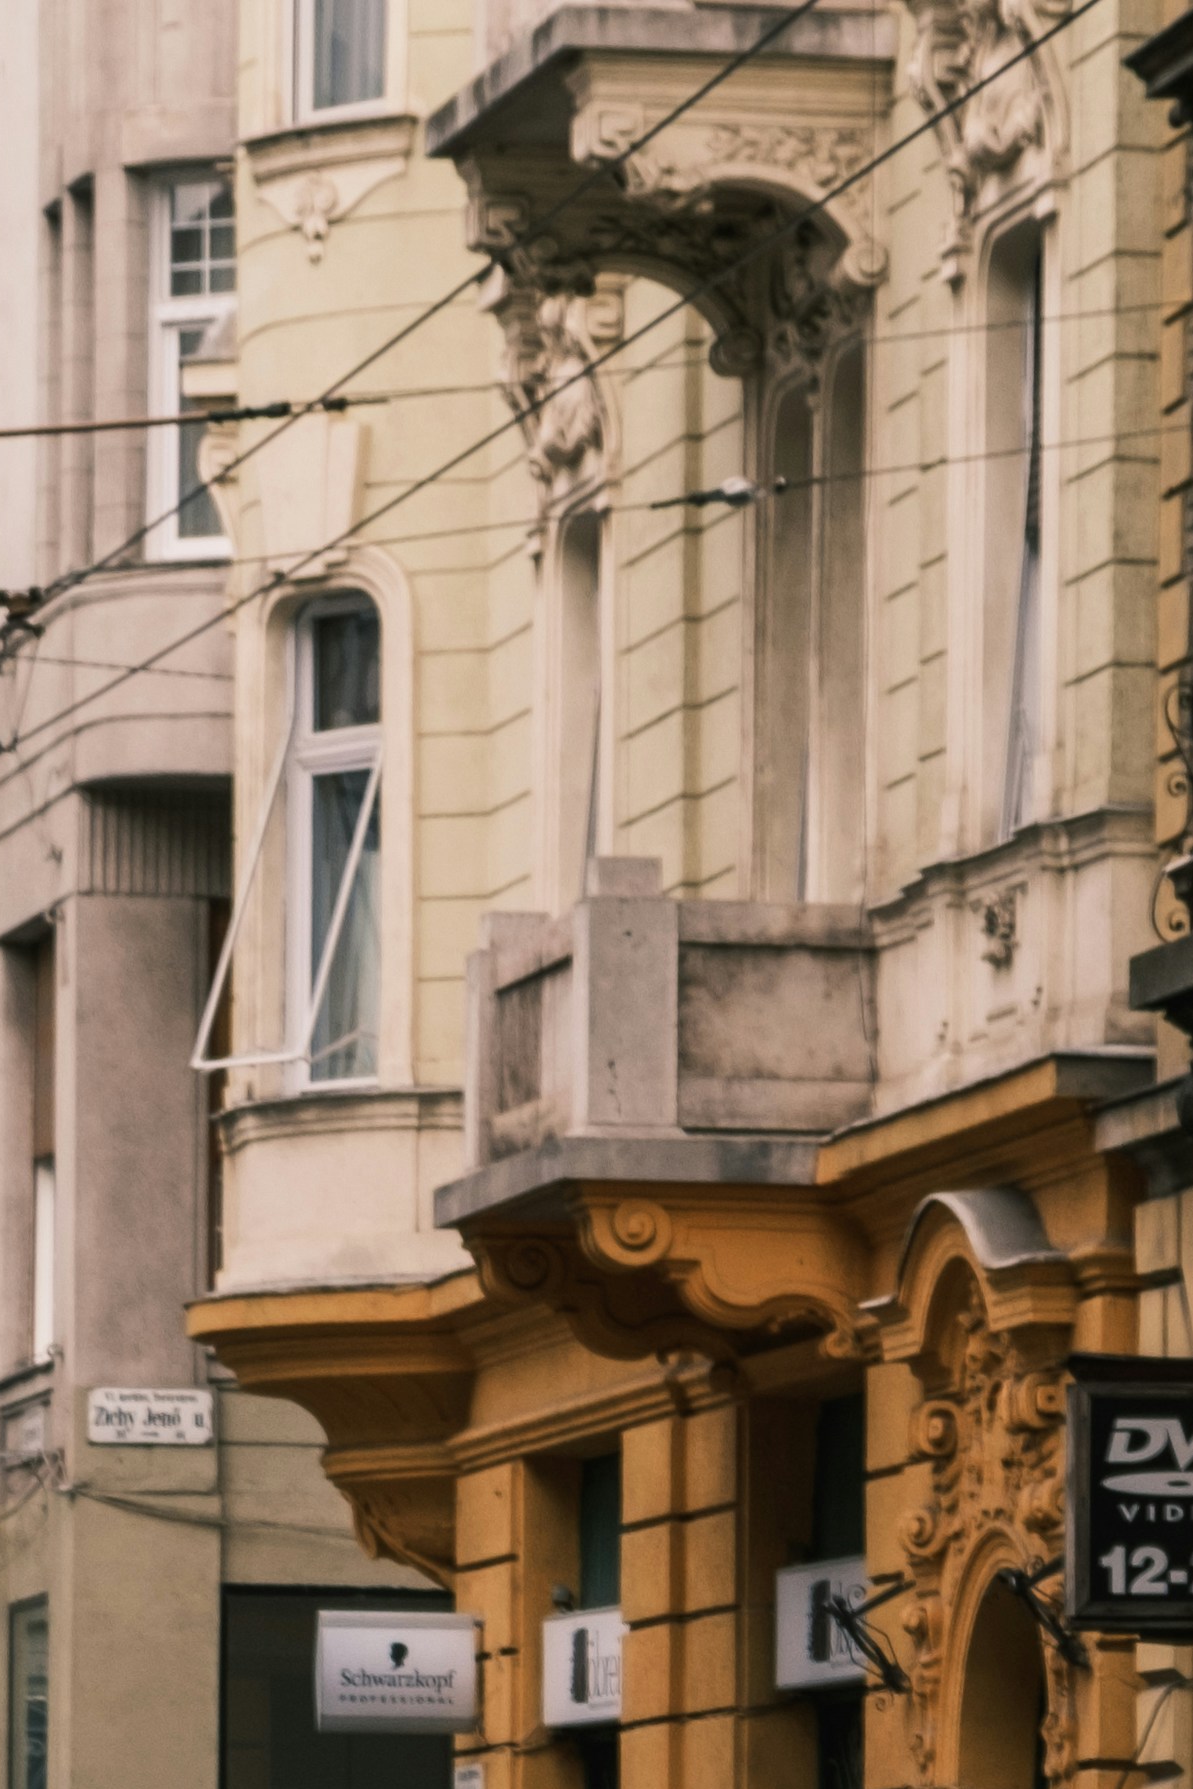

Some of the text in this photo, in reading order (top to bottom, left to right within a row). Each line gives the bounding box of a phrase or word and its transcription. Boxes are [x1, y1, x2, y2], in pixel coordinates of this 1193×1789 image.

[94, 1405, 134, 1432] Zichy
[1119, 1504, 1193, 1523] VID
[1099, 1545, 1193, 1595] 12-
[340, 1668, 457, 1695] Schwarzkopf
[339, 1694, 455, 1704] PROFESSIONAL
